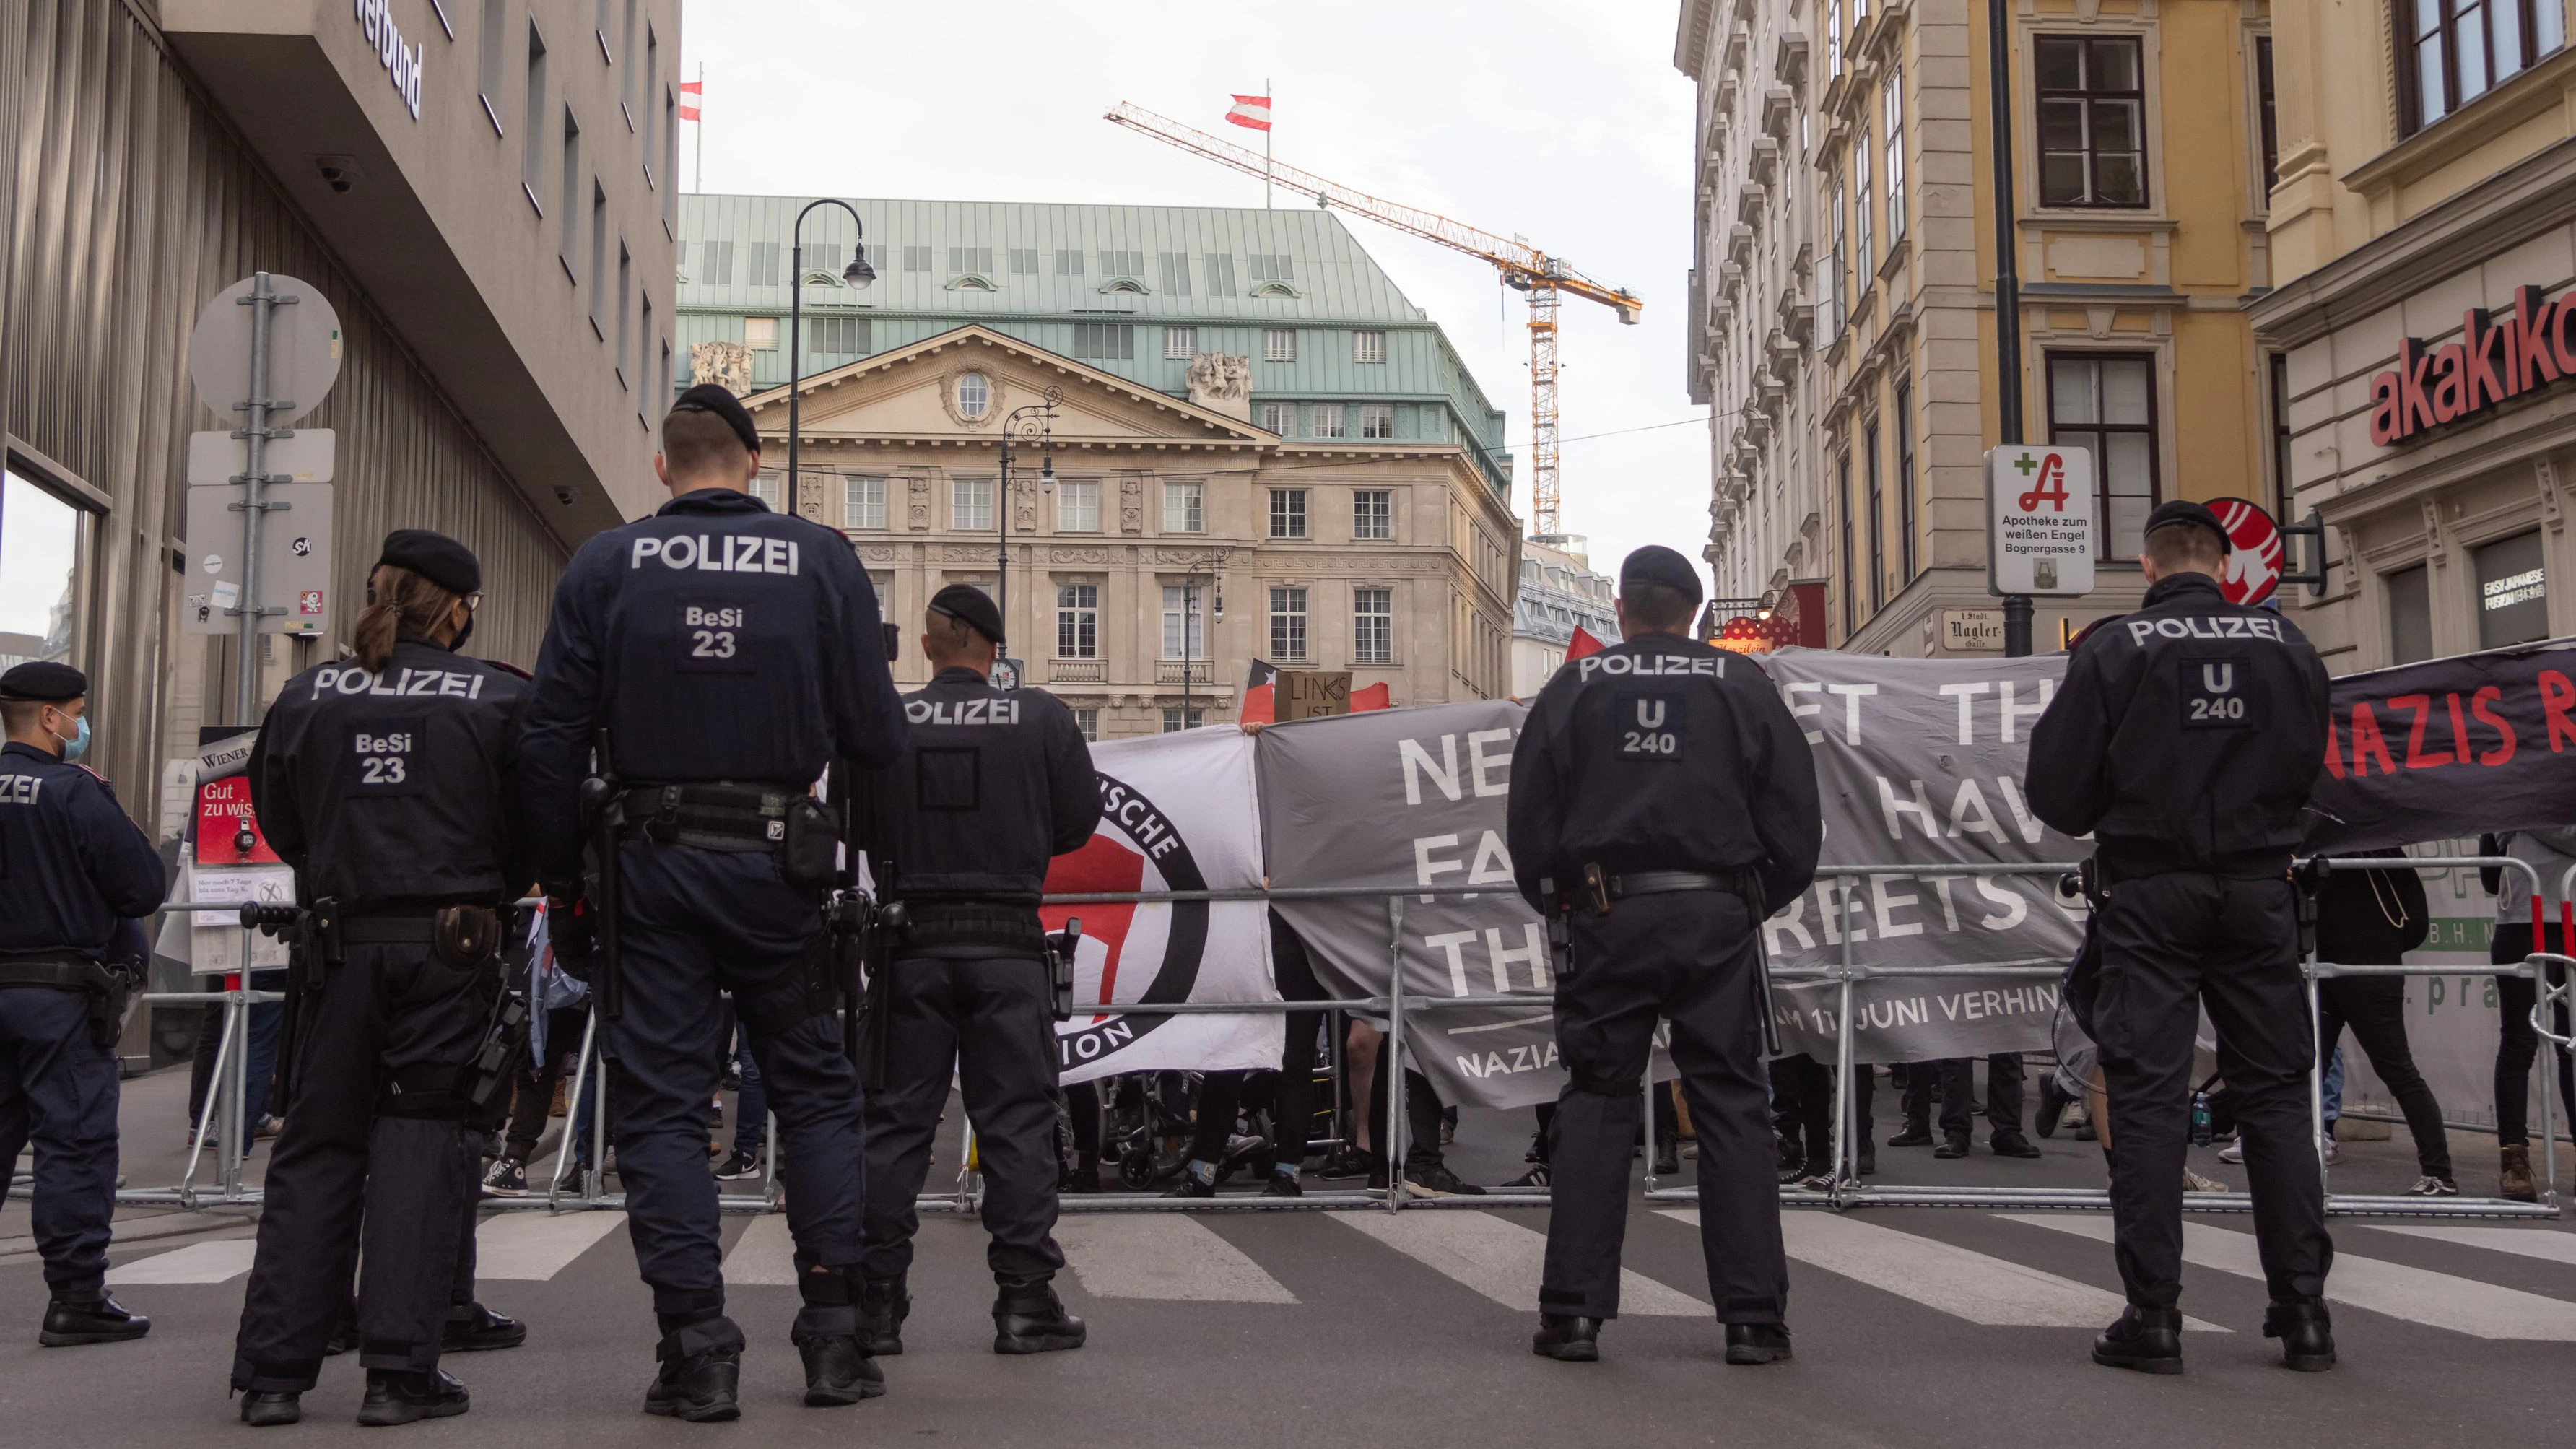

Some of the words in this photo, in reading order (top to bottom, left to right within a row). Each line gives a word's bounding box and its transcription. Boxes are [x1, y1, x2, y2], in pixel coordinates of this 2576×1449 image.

[2002, 515, 2058, 527] Apotheke
[2062, 518, 2087, 527] zum
[2005, 529, 2048, 540] weißen
[2051, 530, 2085, 542] Engel
[631, 534, 799, 576] POLIZEI
[2005, 543, 2076, 555] Bognergasse
[2079, 544, 2085, 554] 9
[685, 606, 743, 627] BeSi
[692, 630, 736, 658] 23
[2127, 617, 2285, 647] POLIZEI
[1580, 655, 1725, 682] POLIZEI
[2203, 663, 2233, 694] U
[311, 667, 484, 701] POLIZEI
[1291, 676, 1346, 702] LINKS
[1637, 699, 1666, 728] U
[2190, 697, 2245, 721] 240
[355, 732, 412, 753] BeSi
[1623, 731, 1676, 754] 240
[362, 757, 406, 784] 23
[204, 782, 234, 800] Gut
[204, 803, 223, 817] zu
[1855, 996, 1929, 1030] JUNI
[1062, 1020, 1133, 1066] ION
